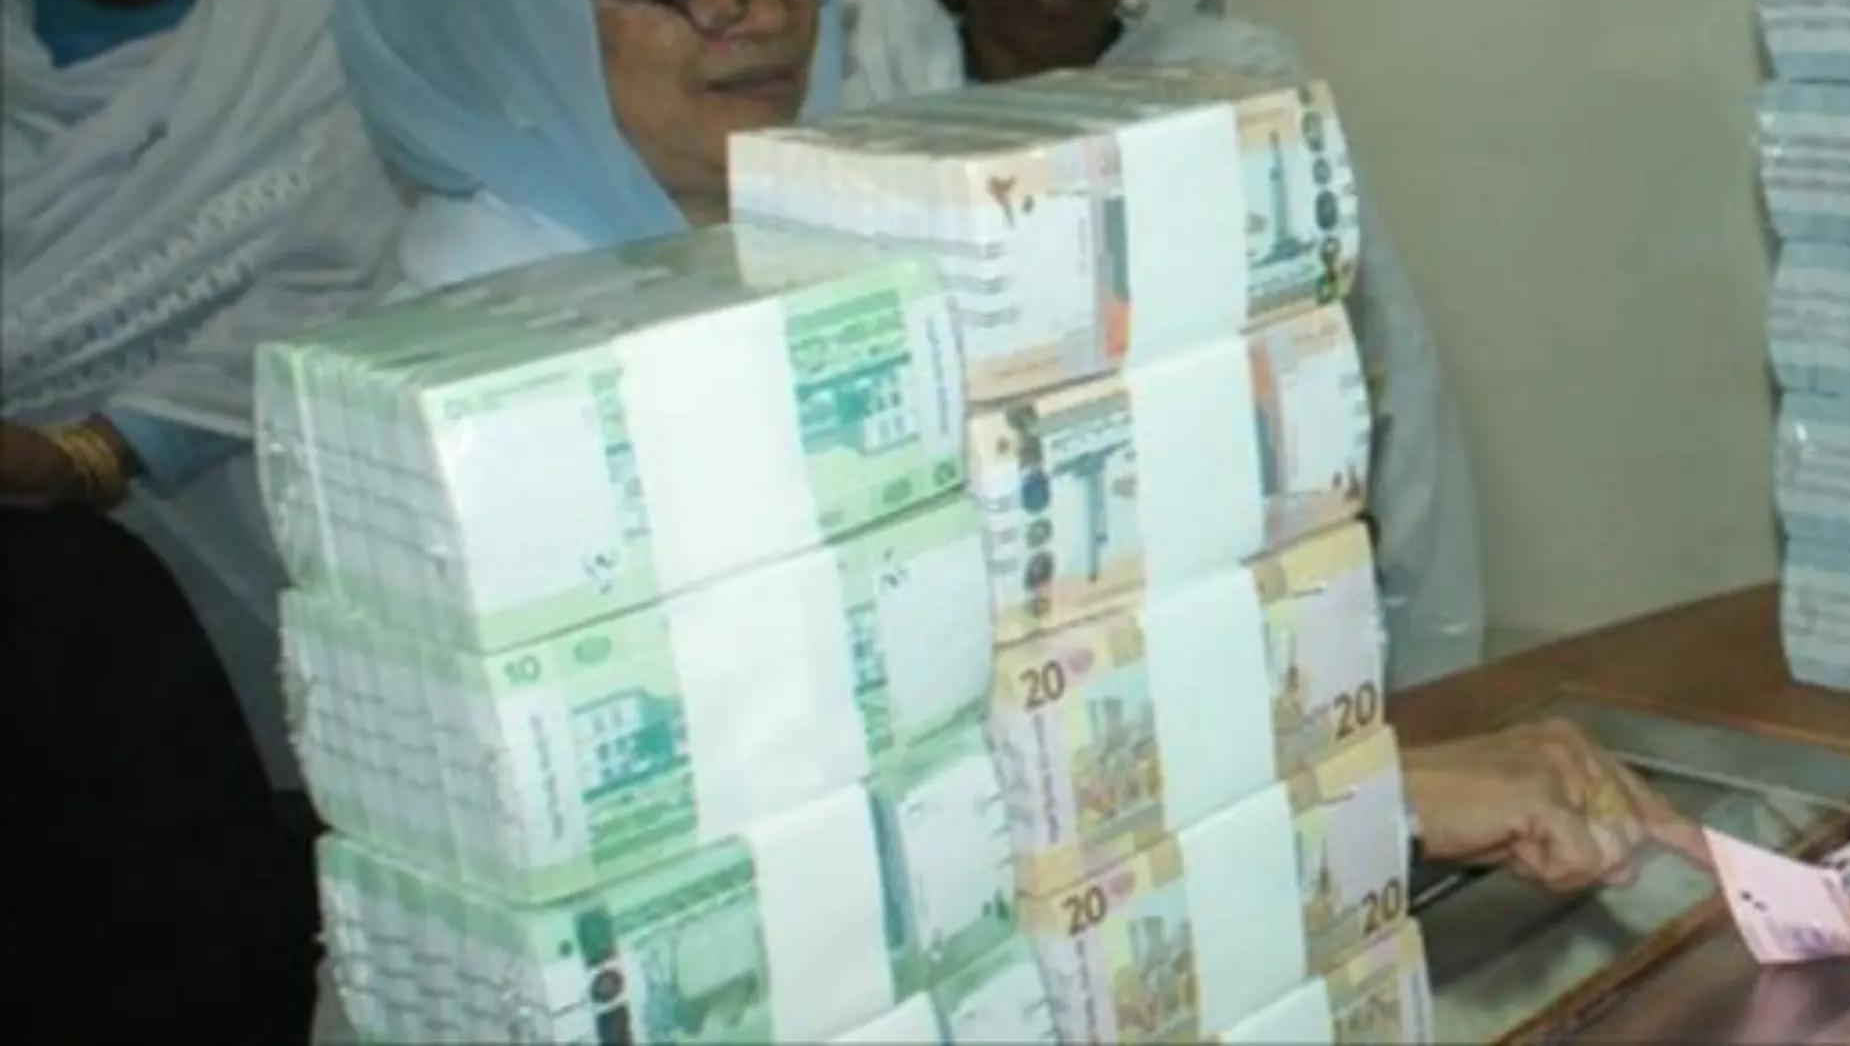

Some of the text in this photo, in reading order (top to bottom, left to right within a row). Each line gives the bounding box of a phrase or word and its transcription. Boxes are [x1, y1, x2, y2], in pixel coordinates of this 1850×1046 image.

[1018, 660, 1067, 710] 20
[1332, 680, 1379, 739] 20
[1060, 887, 1109, 937] 20
[1360, 879, 1402, 936] 20
